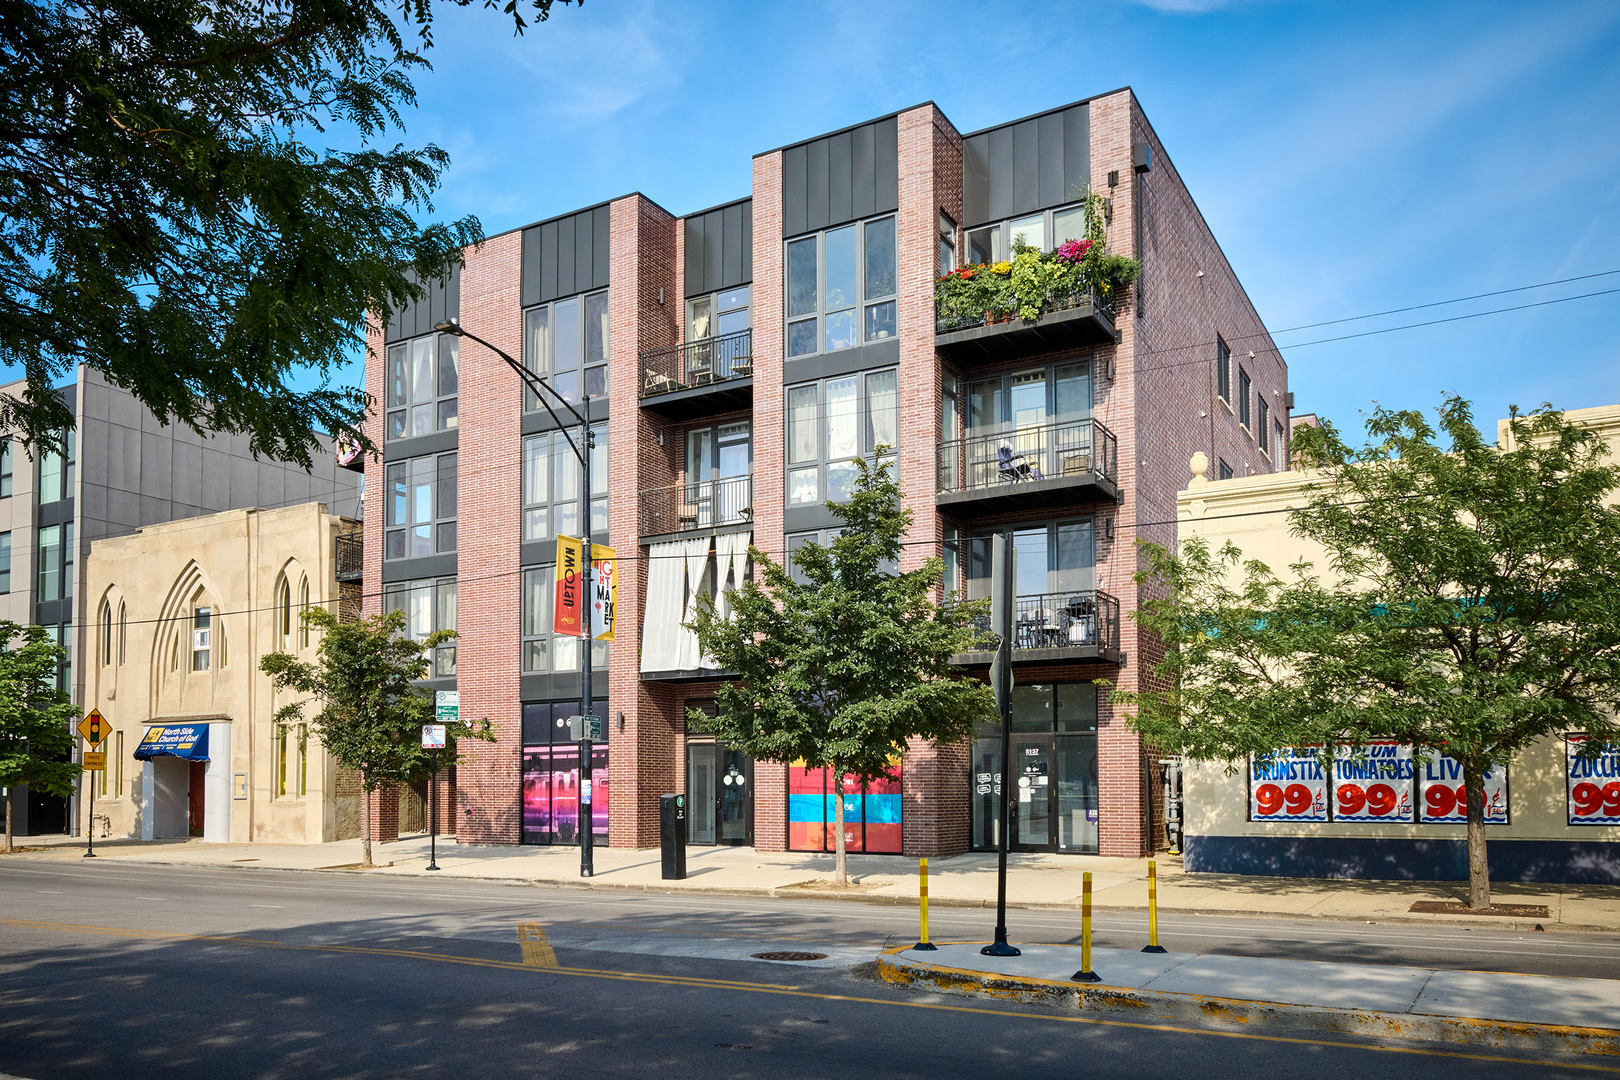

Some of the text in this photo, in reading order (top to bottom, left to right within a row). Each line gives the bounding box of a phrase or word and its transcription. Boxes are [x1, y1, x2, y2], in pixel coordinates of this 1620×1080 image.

[563, 547, 575, 607] UPTOWN
[180, 727, 195, 735] Side
[186, 734, 199, 742] God
[1252, 760, 1324, 781] DRUMSTIX
[1334, 758, 1414, 780] TOMATOES
[1426, 759, 1492, 781] LIV
